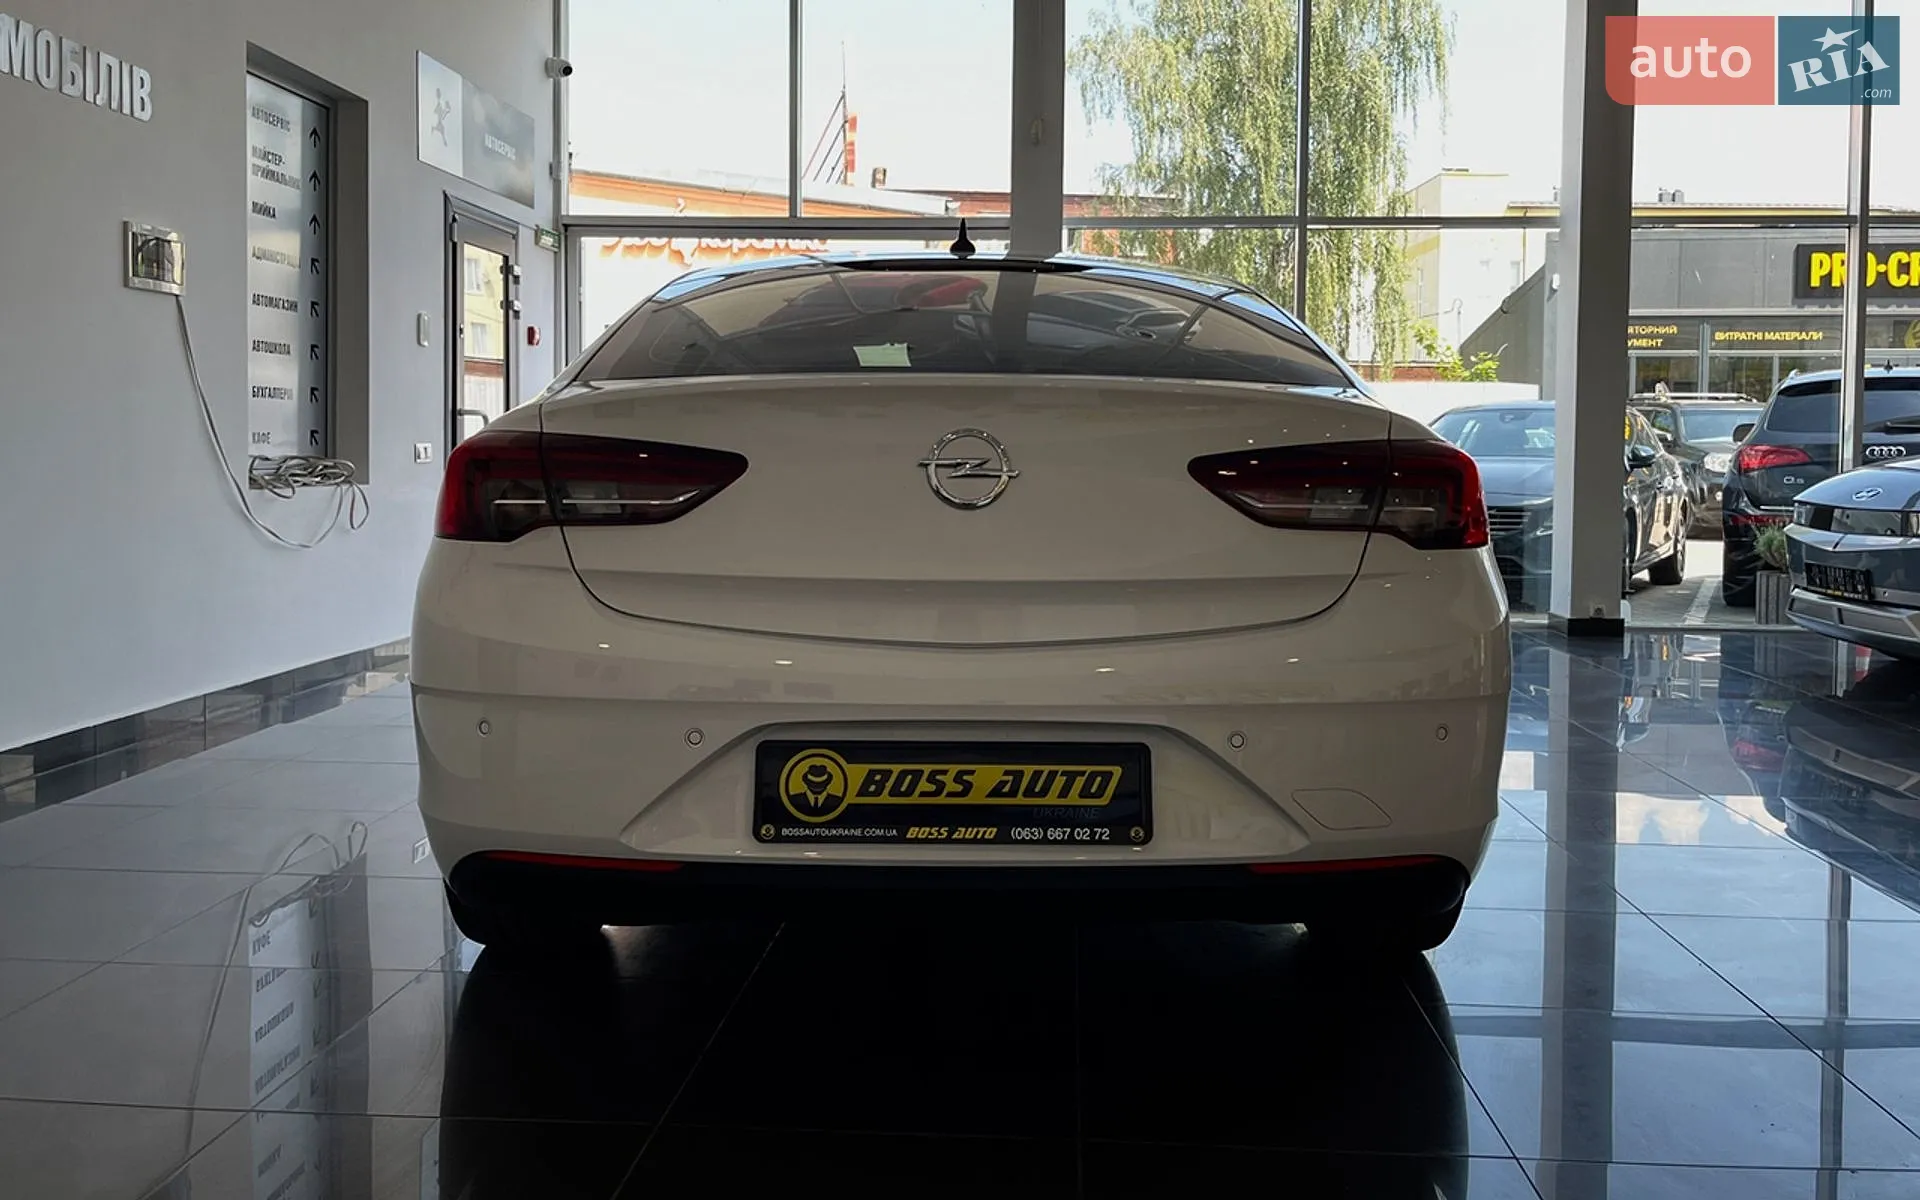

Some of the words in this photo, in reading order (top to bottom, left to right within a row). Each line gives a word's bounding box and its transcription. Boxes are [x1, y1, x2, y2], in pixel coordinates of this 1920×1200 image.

[251, 292, 299, 313] АВТОМАГАЗИН
[1714, 331, 1763, 341] ВИТРАТНІ
[1764, 331, 1823, 341] МАТЕРІАЛИ
[251, 339, 291, 356] АВТОШКОЛА
[855, 768, 977, 798] BOSS
[985, 769, 1115, 799] AUTO
[1032, 806, 1099, 820] UKRAINE
[906, 826, 949, 839] BOSS
[951, 827, 997, 839] AUTO
[1010, 827, 1044, 841] (063)
[1047, 828, 1070, 840] 667
[1074, 828, 1090, 840] 02
[1093, 828, 1110, 840] 72
